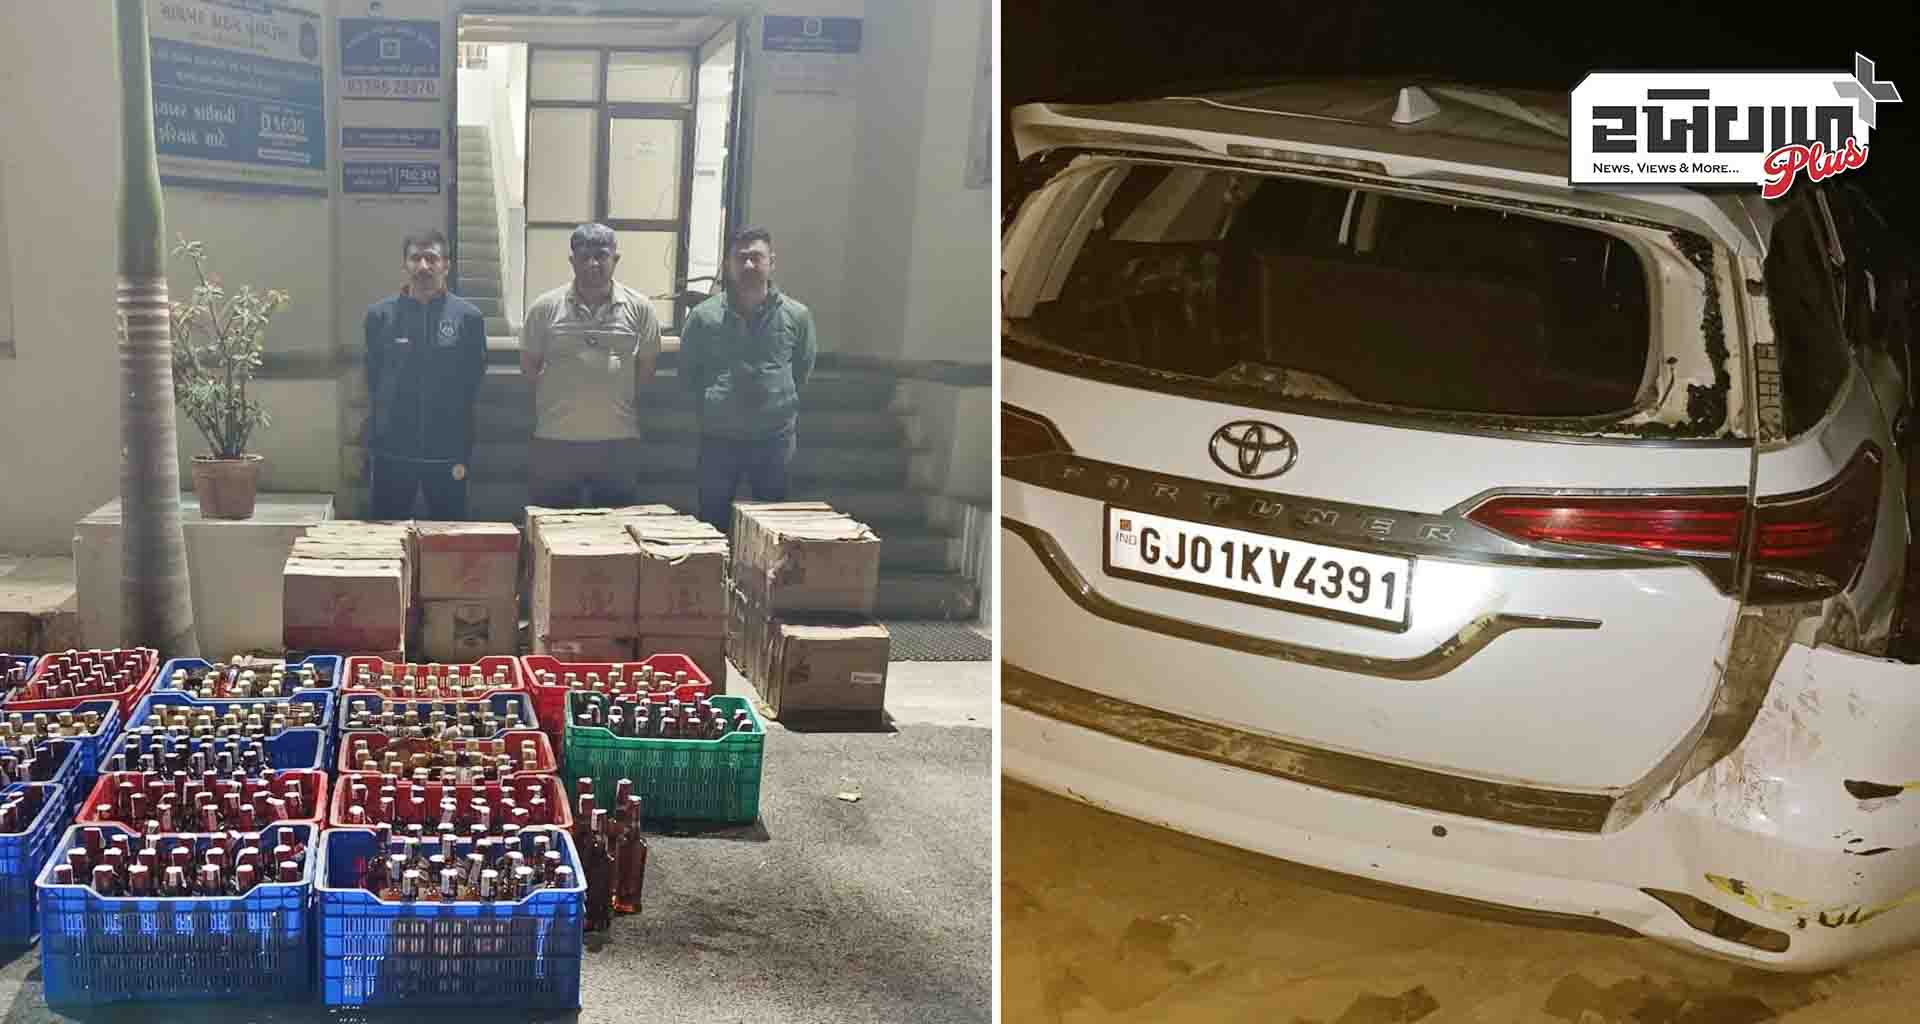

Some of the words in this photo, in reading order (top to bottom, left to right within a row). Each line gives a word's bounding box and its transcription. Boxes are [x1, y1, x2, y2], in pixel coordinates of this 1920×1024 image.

[1062, 465, 1457, 543] FORTUNER
[1115, 531, 1137, 546] IND
[1139, 526, 1397, 610] GJ01KV4391
